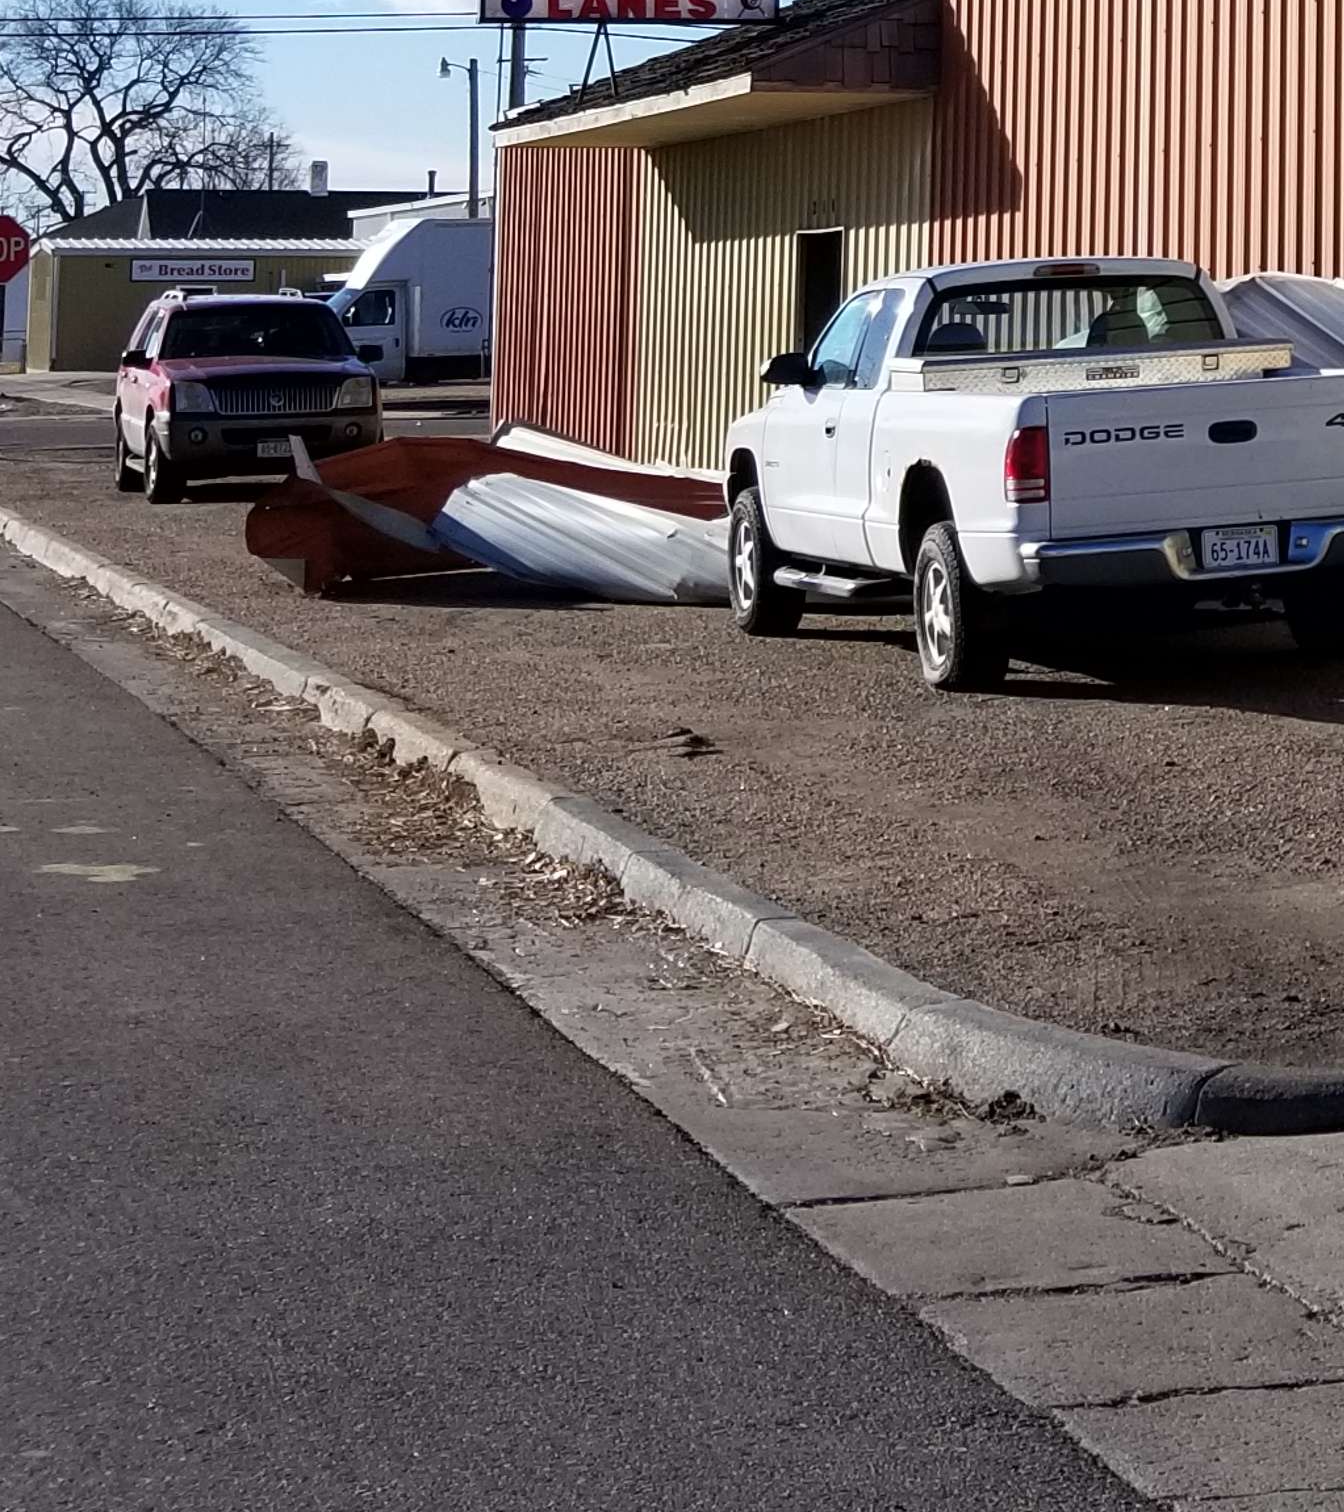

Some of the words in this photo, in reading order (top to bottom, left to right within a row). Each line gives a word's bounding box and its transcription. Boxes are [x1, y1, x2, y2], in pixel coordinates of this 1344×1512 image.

[0, 236, 25, 262] OP
[158, 263, 205, 276] Bread
[207, 263, 251, 277] Store
[1063, 423, 1184, 446] DODGE
[1211, 539, 1270, 562] 65-174A
